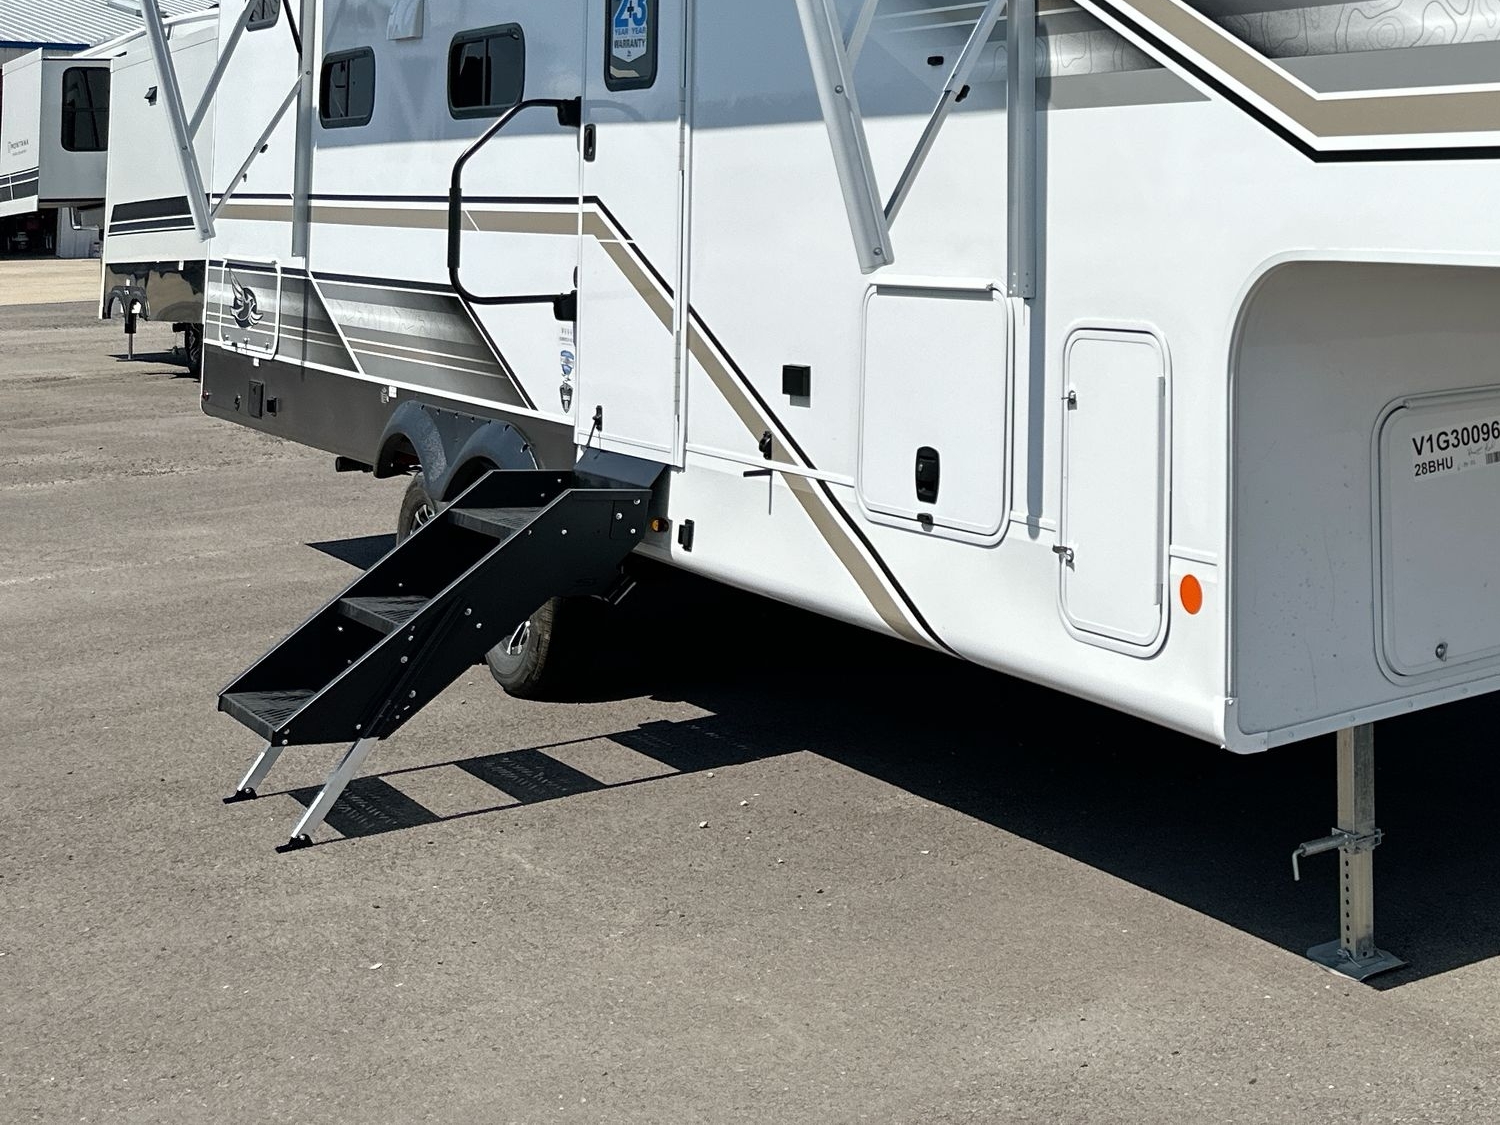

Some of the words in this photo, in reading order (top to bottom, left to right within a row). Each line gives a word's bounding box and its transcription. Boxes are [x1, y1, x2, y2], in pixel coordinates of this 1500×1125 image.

[614, 28, 629, 36] YEAR
[631, 26, 646, 35] YEAR
[614, 38, 645, 49] WARRANTY
[1412, 420, 1500, 456] V1G30096
[1414, 456, 1454, 477] 28BHU
